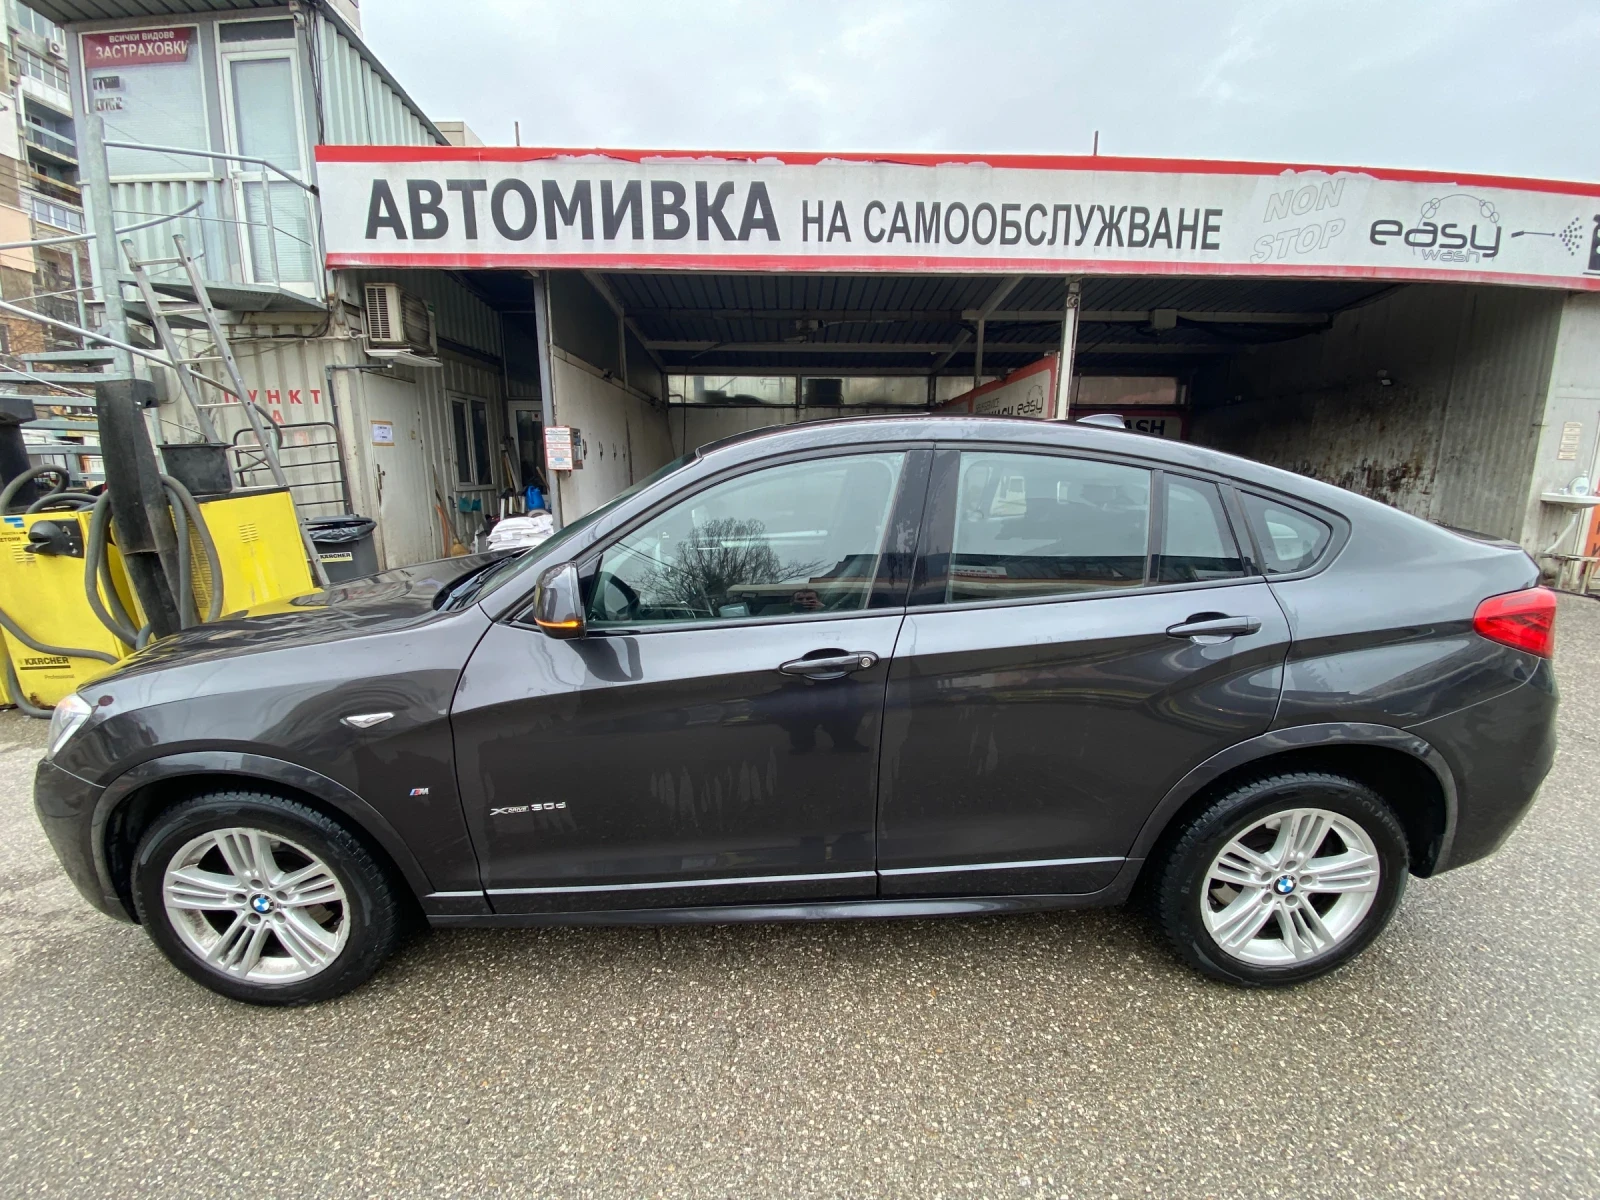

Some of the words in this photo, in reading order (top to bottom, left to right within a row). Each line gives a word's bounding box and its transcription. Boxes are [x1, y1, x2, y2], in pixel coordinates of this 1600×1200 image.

[364, 177, 781, 242] АВТОМИВКА
[801, 199, 852, 243] НА
[863, 199, 1224, 251] САМООБСЛУЖВАНЕ
[1263, 177, 1347, 223] NON
[1249, 218, 1346, 265] STOP
[1369, 219, 1502, 259] easy
[1421, 247, 1481, 263] wash
